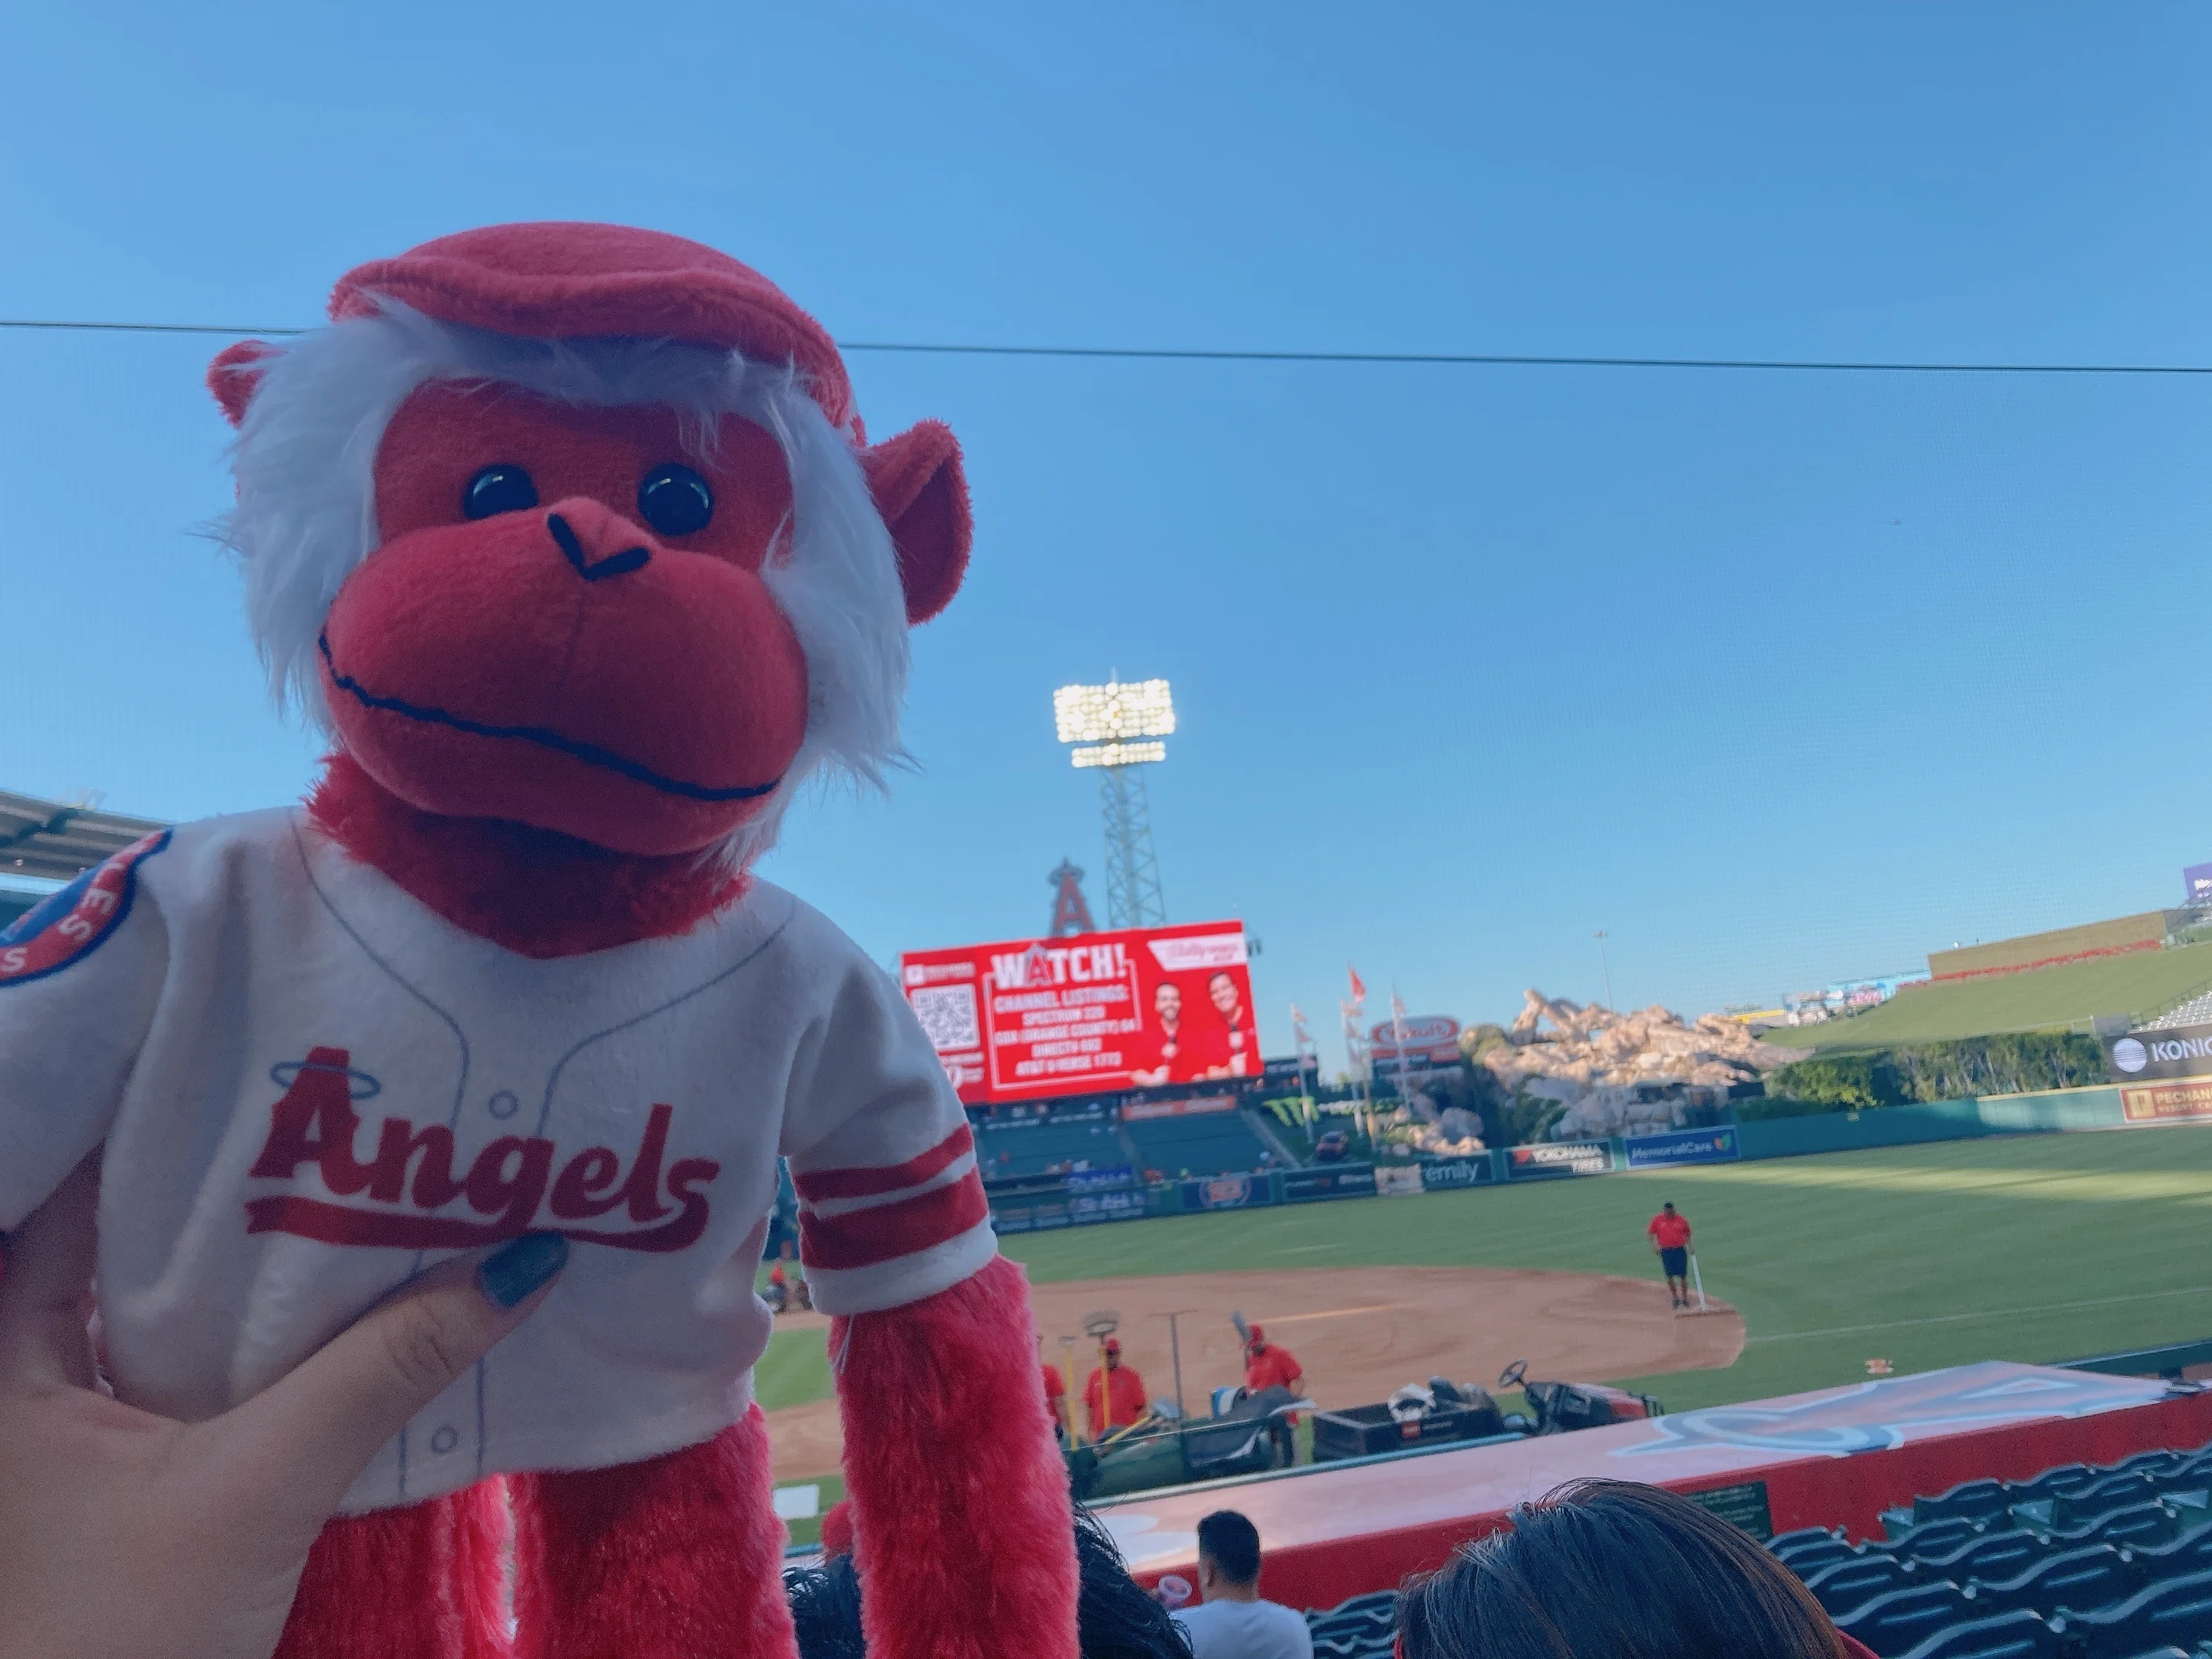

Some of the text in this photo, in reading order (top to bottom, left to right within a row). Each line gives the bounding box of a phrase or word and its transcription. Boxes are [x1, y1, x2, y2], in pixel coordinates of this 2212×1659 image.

[991, 943, 1127, 989] WATCH!
[247, 1045, 722, 1232] Angels
[1532, 1144, 1603, 1163] YOKOHAMA
